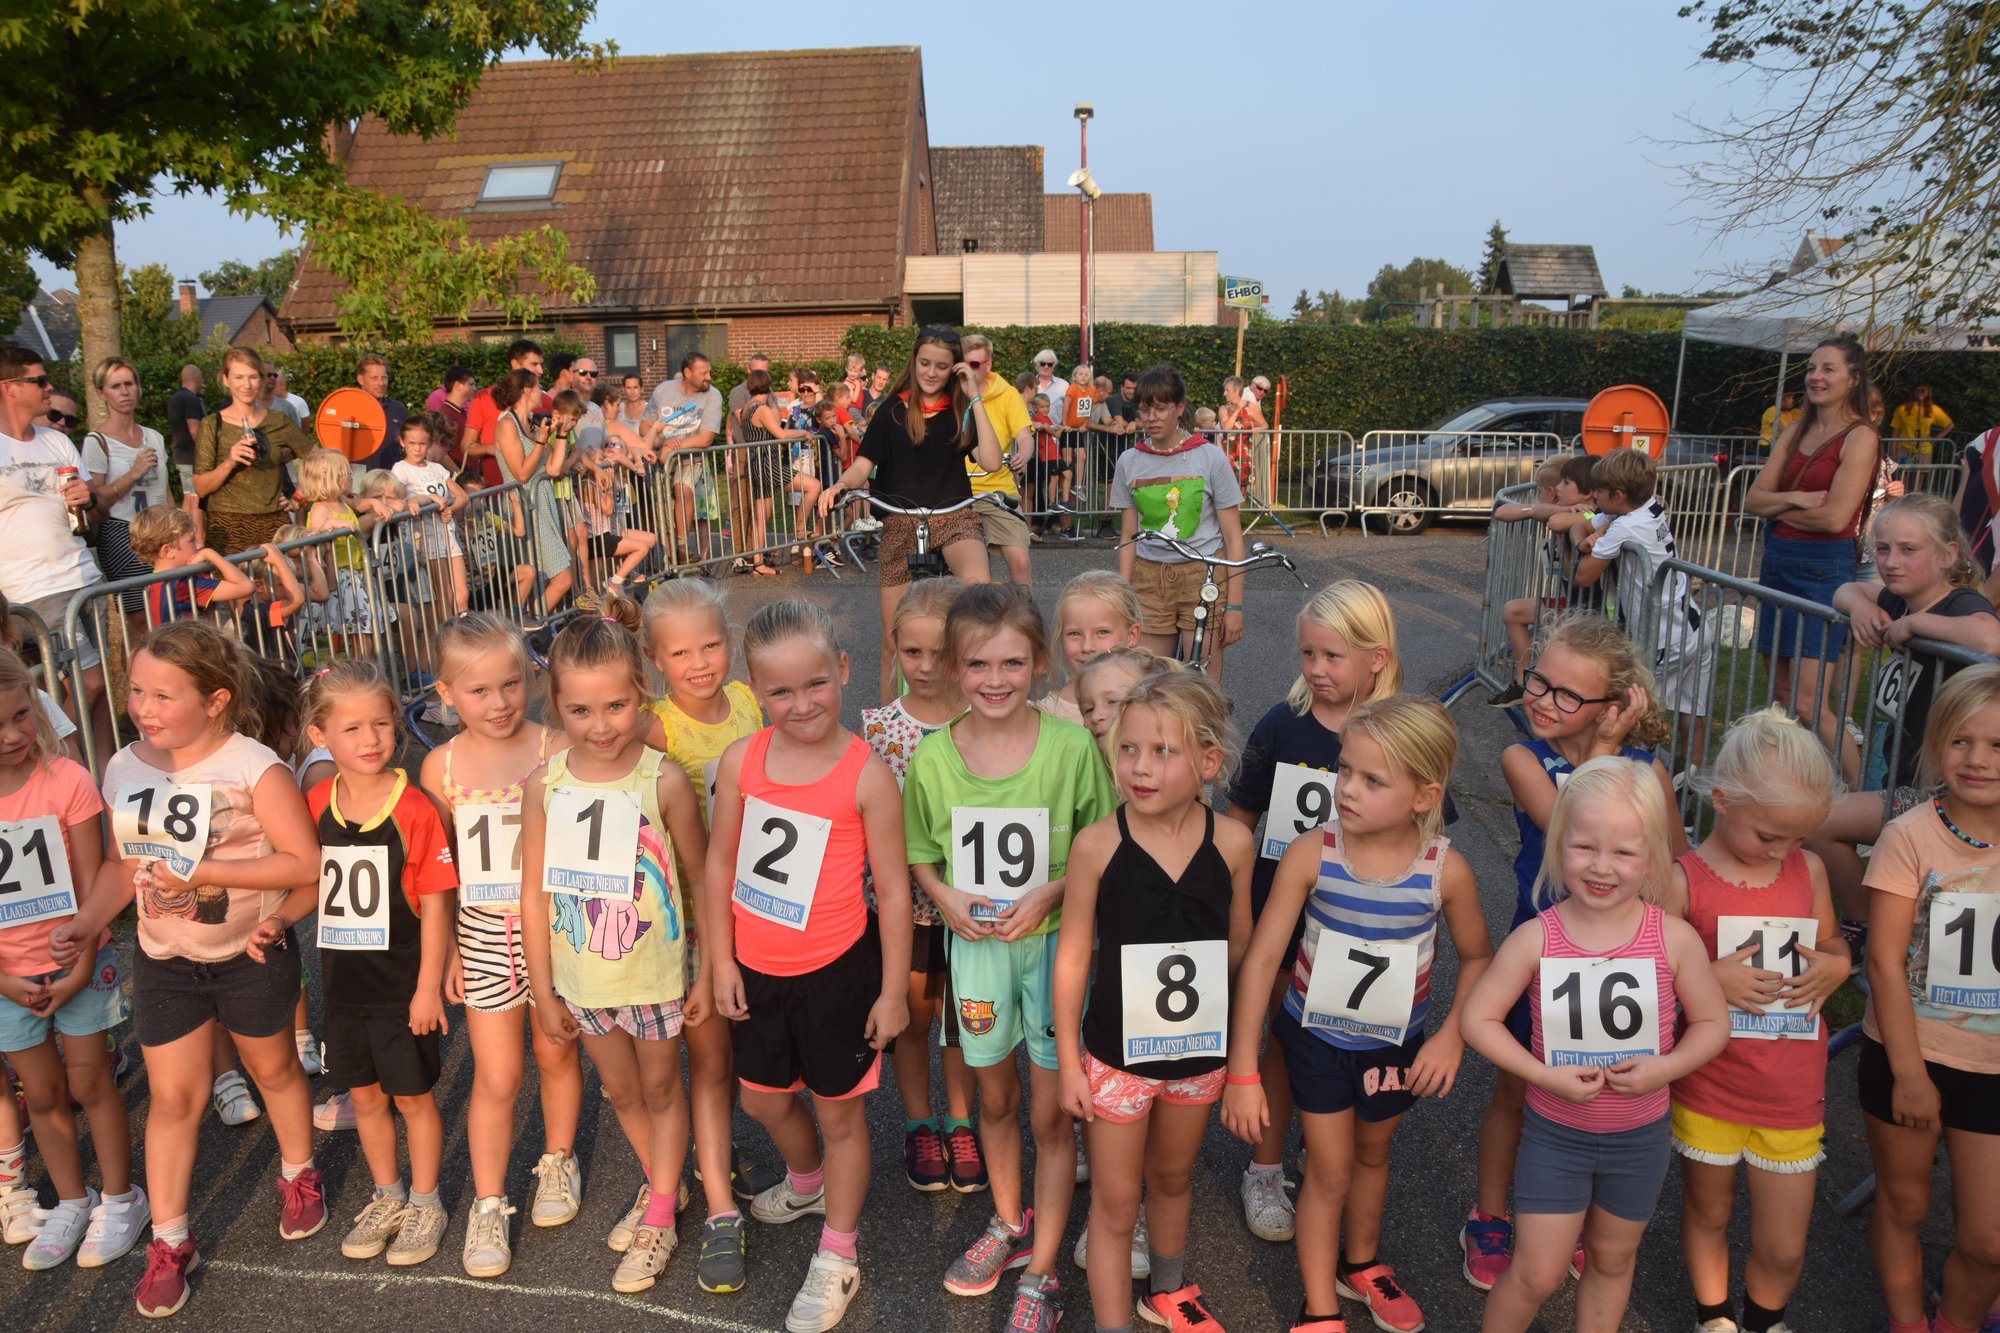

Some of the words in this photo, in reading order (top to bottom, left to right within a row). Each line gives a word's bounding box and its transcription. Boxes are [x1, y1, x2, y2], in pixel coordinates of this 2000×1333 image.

[1227, 285, 1261, 299] EHBO
[1078, 399, 1091, 410] 93
[127, 788, 199, 842] 18
[1294, 782, 1331, 834] 9
[468, 814, 522, 872] 17
[576, 799, 605, 860] 1
[0, 828, 55, 894] 21
[128, 843, 143, 854] HET
[752, 817, 798, 885] 2
[962, 822, 1035, 888] 19
[1269, 841, 1285, 857] HET
[324, 859, 380, 918] 20
[470, 886, 485, 899] HET
[485, 885, 514, 899] LAATSTE
[551, 869, 566, 885] HET
[566, 871, 595, 889] LAATSTE
[596, 875, 625, 892] NIEUWS
[4, 899, 38, 920] LAATSTE
[37, 895, 69, 912] NIEUWS
[736, 881, 746, 899] HET
[746, 887, 772, 912] LAATSTE
[770, 898, 800, 921] NIEUWS
[331, 929, 356, 944] LAATSTE
[356, 930, 383, 944] NIEUWS
[1736, 930, 1801, 989] 11
[1156, 954, 1199, 1022] 8
[1346, 948, 1390, 1010] 7
[1553, 972, 1643, 1040] 16
[1935, 987, 1957, 1003] HET
[1957, 989, 1997, 1008] LAATSTE
[1312, 1013, 1328, 1024] HET
[1329, 1016, 1364, 1033] LAATSTE
[1365, 1023, 1396, 1038] NIEUWS
[1729, 1012, 1747, 1030] HET
[1748, 1013, 1785, 1031] LAATSTE
[1786, 1015, 1811, 1031] NIEUWS
[1132, 1040, 1149, 1056] HET
[1150, 1038, 1185, 1054] LAATSTE
[1186, 1035, 1217, 1051] NIEUWS
[1556, 1051, 1575, 1066] HET
[1575, 1053, 1614, 1068] LAATSTE
